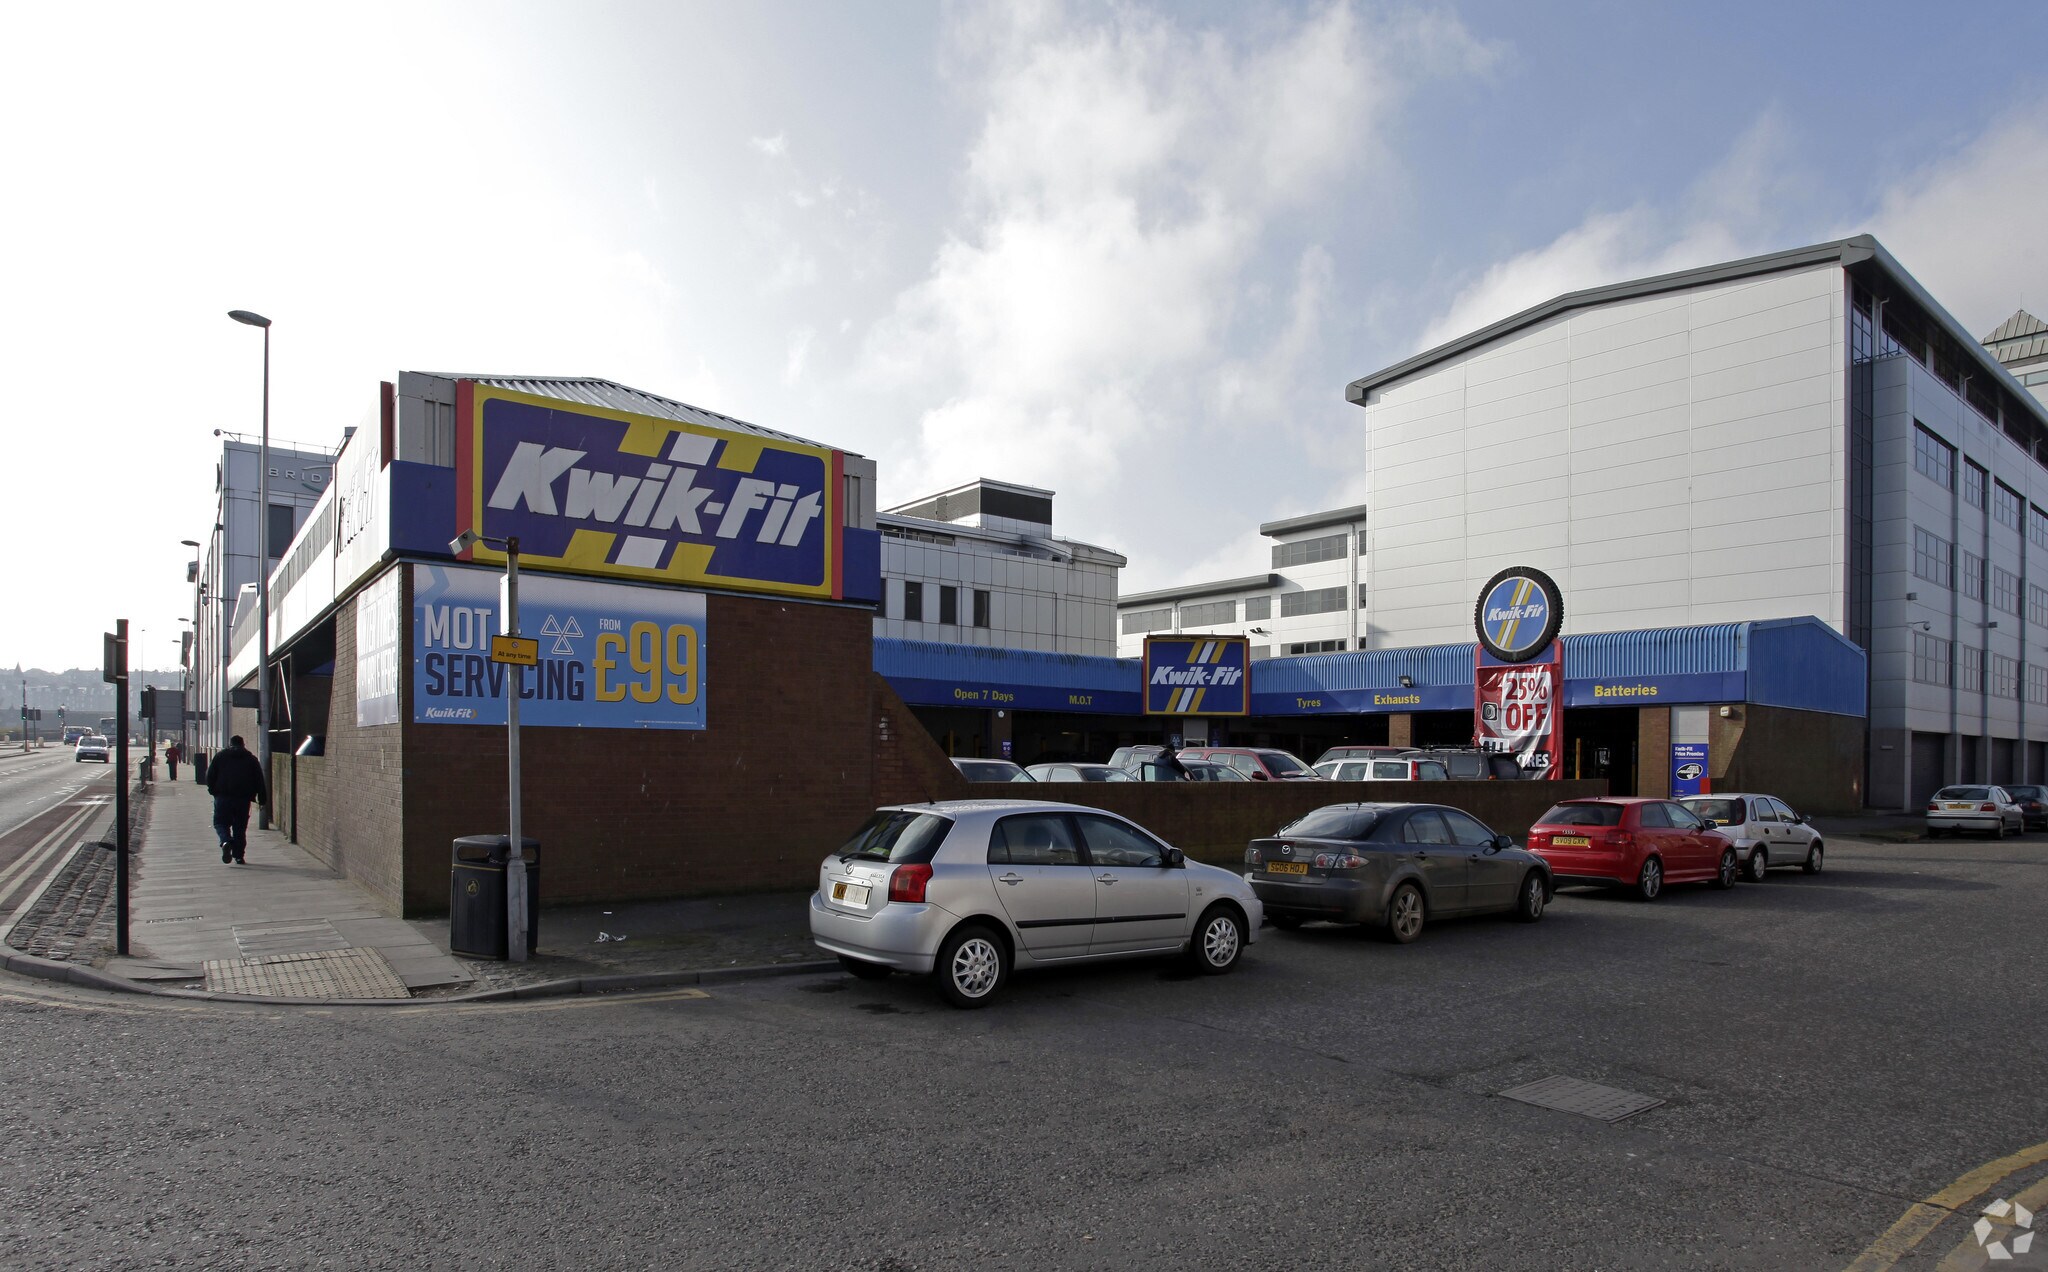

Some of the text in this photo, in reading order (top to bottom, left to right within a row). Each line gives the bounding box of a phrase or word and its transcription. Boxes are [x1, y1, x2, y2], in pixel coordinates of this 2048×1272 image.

[488, 441, 822, 547] Kwik-Fit
[1487, 604, 1544, 621] Kwik-Fit
[424, 604, 492, 651] MOT
[599, 618, 621, 631] FROM
[592, 621, 698, 705] £99
[1150, 666, 1242, 685] Kwik-Fit
[954, 688, 1014, 702] Open 7 Days
[1506, 677, 1548, 700] 25%
[1594, 684, 1658, 697] Batteries
[1069, 695, 1093, 705] M.O.T
[1297, 698, 1321, 709] Tyres
[1374, 694, 1420, 705] Exhausts
[1506, 703, 1548, 731] OFF
